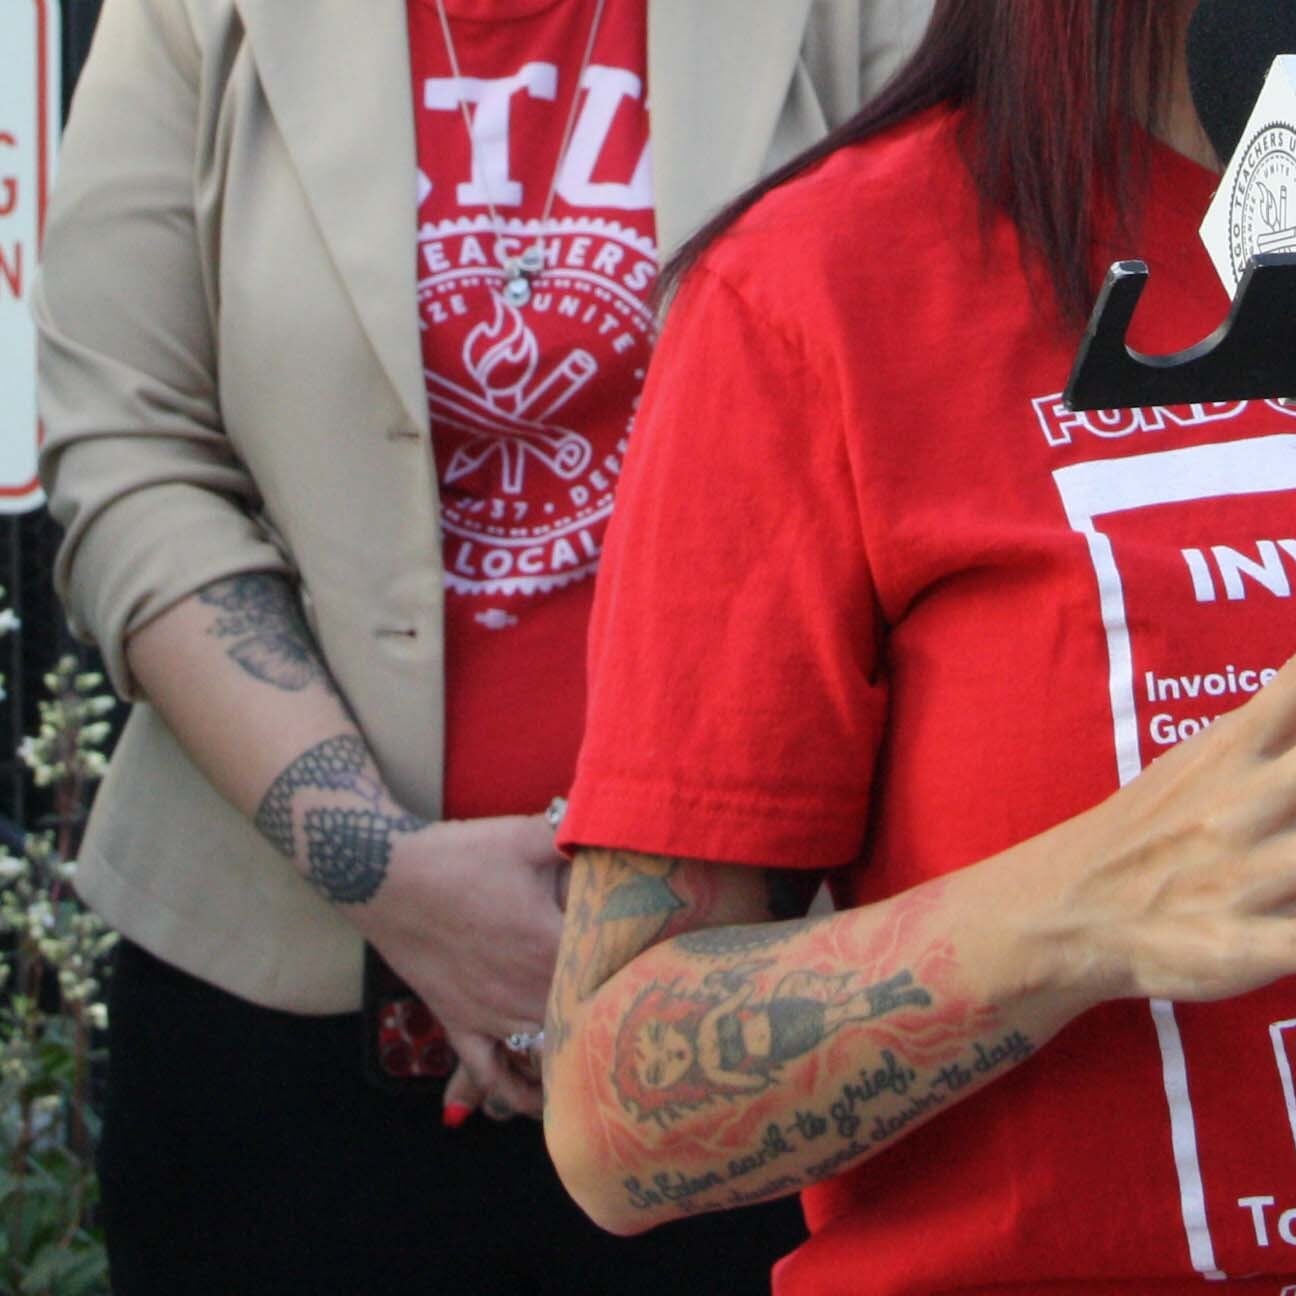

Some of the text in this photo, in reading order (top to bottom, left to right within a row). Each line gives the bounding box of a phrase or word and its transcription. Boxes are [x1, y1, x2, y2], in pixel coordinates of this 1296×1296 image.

[1234, 132, 1283, 208] TEACHERS
[421, 235, 657, 292] EACHERS
[532, 293, 636, 354] UNITE
[455, 528, 603, 580] LOCAL
